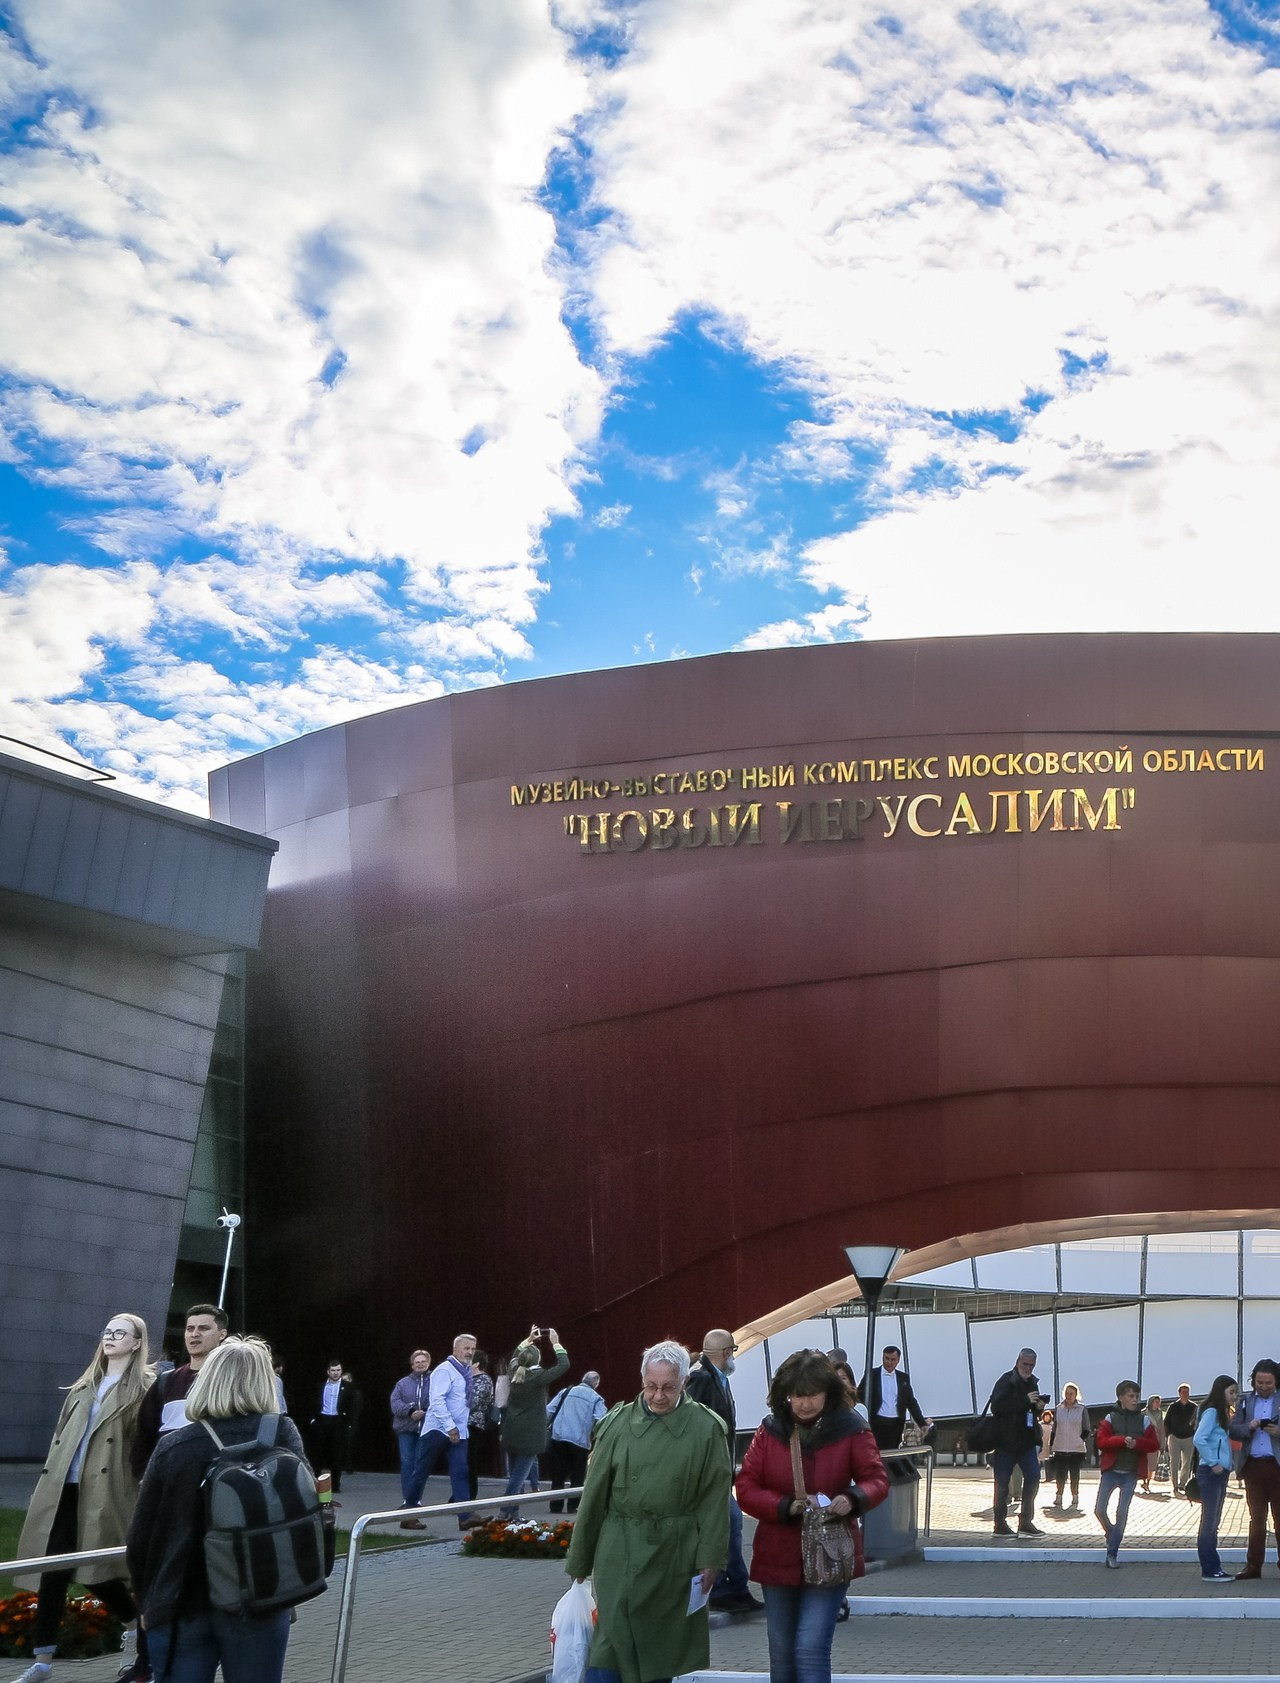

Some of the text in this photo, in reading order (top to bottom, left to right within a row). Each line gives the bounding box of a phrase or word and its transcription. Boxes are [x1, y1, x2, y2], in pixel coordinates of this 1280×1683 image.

[803, 756, 939, 786] КОМПЛЕКС
[947, 745, 1133, 780] МОСКОВСКОЙ
[1142, 748, 1265, 772] ОБЛАСТИ
